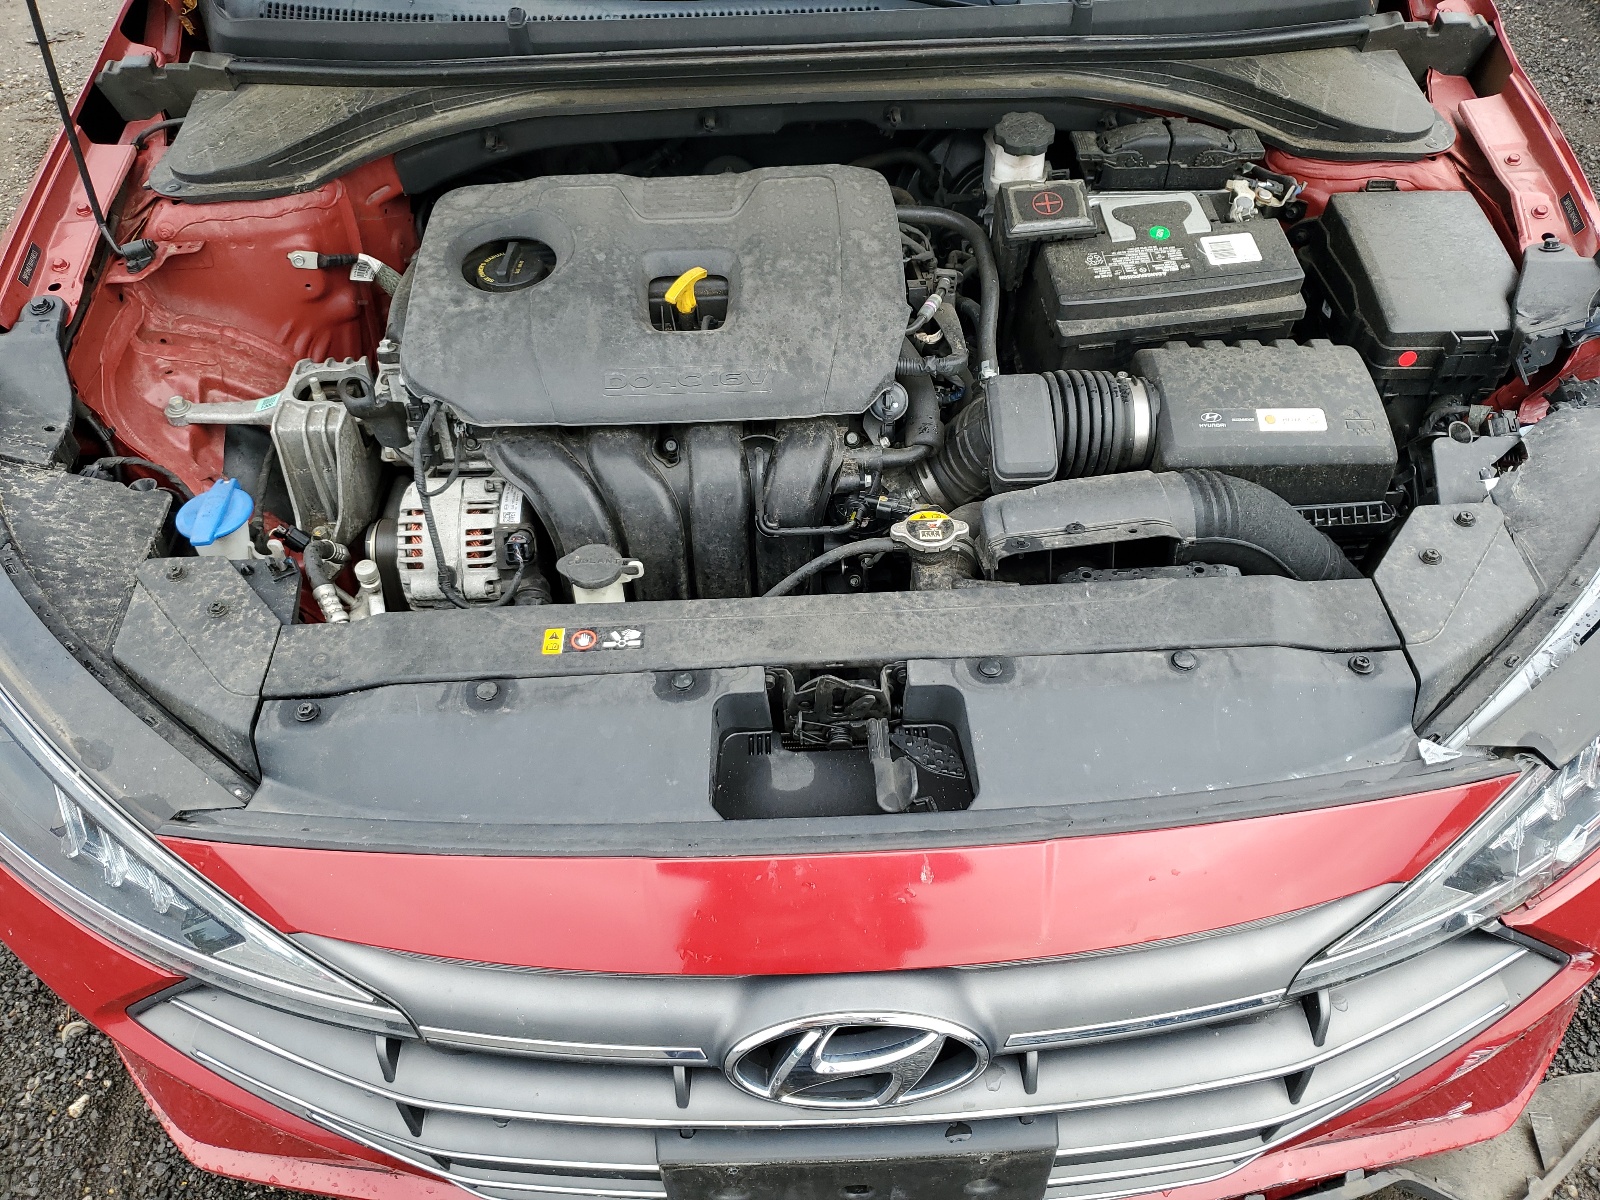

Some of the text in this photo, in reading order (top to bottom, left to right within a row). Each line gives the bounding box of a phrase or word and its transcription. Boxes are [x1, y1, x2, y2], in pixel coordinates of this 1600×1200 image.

[603, 370, 769, 390] DOHC 16V
[567, 557, 621, 566] COOLANT
